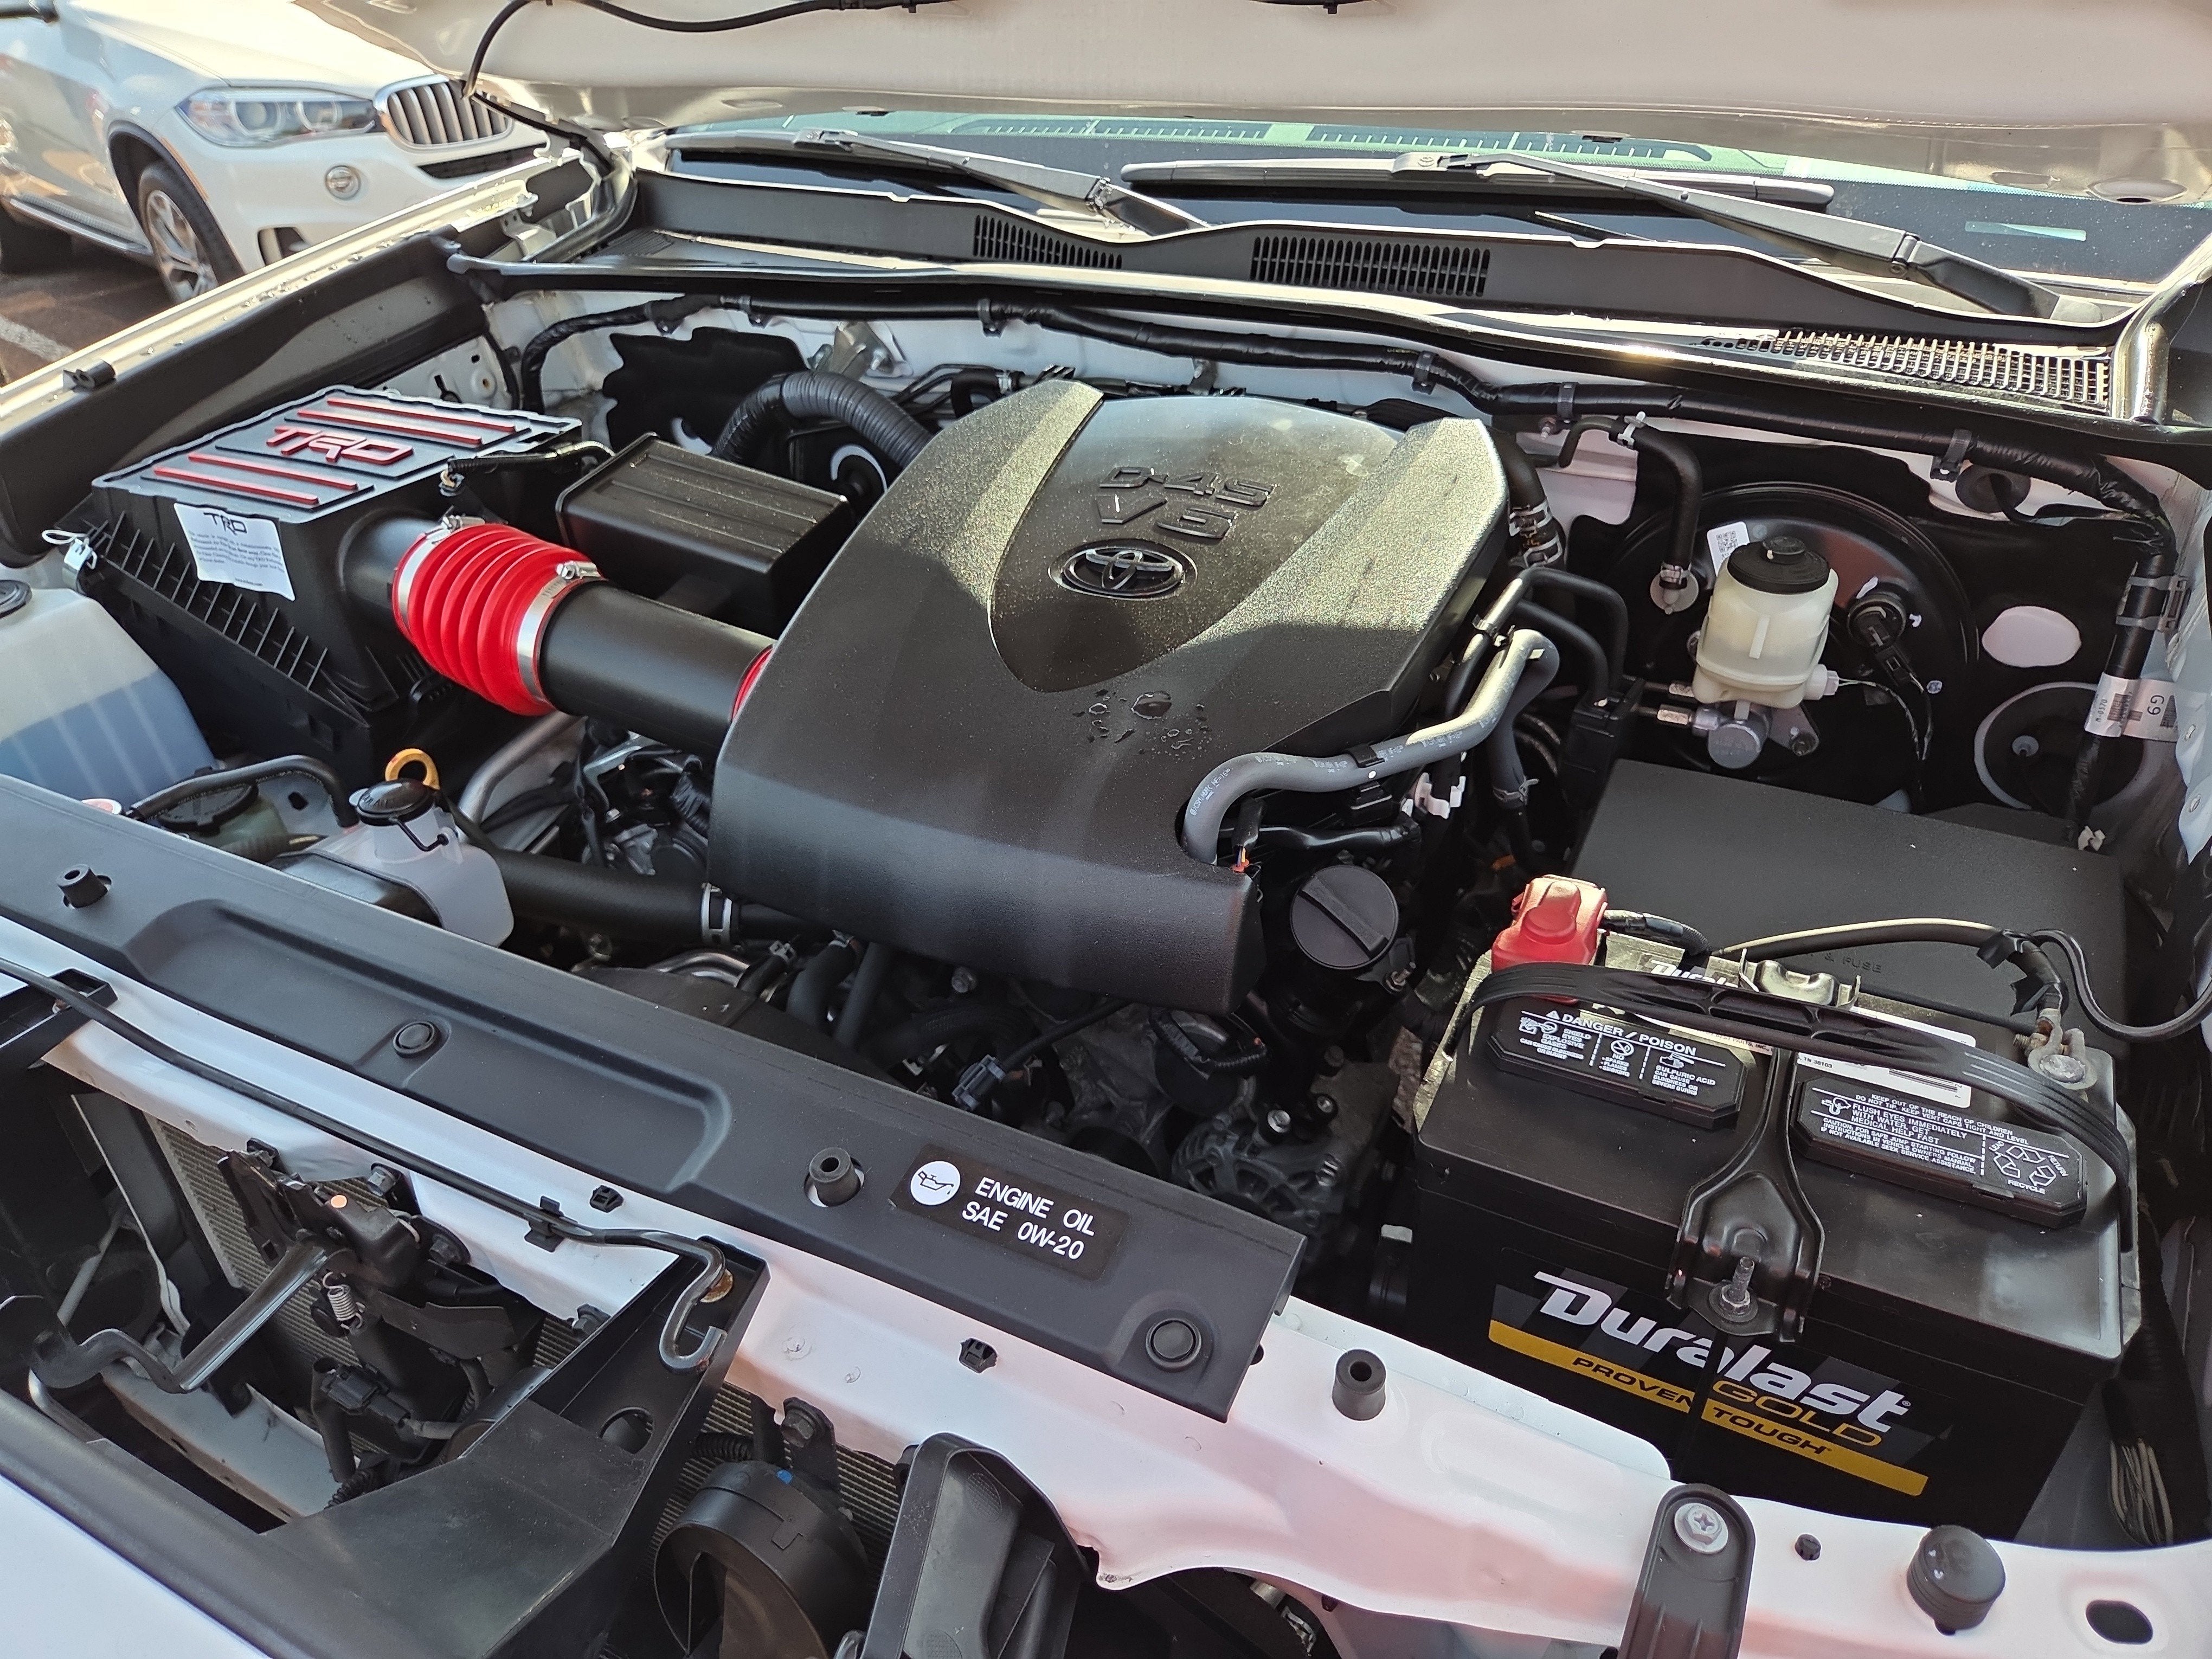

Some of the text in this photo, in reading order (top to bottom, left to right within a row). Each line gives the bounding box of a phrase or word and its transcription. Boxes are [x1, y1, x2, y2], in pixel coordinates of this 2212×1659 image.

[267, 426, 413, 466] TRD
[203, 512, 247, 536] TRD
[1095, 494, 1237, 539] V6
[2147, 695, 2164, 715] G9
[1842, 956, 1882, 973] FUSE
[1540, 1038, 1567, 1049] GASES
[1542, 1033, 1585, 1049] EXPLOSIVE
[1561, 1033, 1583, 1043] EYES
[1562, 1013, 1624, 1037] DANGER
[1638, 1033, 1697, 1056] POISON
[1563, 1028, 1592, 1040] SHIELD
[1655, 1065, 1716, 1086] SULFURIC ACID
[1813, 1058, 1833, 1069] 38103
[1851, 1115, 1940, 1144] MEDICAL HELP FAST
[1852, 1103, 1967, 1140] FLUSH EYES IMMEDIATELY
[1852, 1109, 1874, 1121] WITH
[1912, 1125, 1931, 1136] GET
[1868, 1098, 1884, 1107] NOT
[1901, 1107, 1920, 1116] KEEP
[1921, 1112, 1941, 1122] VENT
[1943, 1117, 1963, 1127] CAPS
[1965, 1123, 1988, 1134] TIGHT
[1989, 1129, 2005, 1139] AND
[2005, 1134, 2029, 1145] LEVEL
[1872, 1094, 1890, 1103] KEEP
[1891, 1098, 1907, 1107] OUT
[1921, 1107, 1937, 1115] THE
[1938, 1111, 1963, 1123] REACH
[1976, 1121, 2014, 1136] CHILDREN
[1823, 1122, 1871, 1142] INSTRUCTIONS
[1882, 1137, 1910, 1152] VEHICLE
[1911, 1146, 1942, 1159] OWNERS
[1828, 1128, 1844, 1138] NOT
[1844, 1133, 1880, 1148] AVAILABLE
[1881, 1143, 1899, 1154] SEEK
[1900, 1149, 1930, 1161] SERVICE
[1855, 1125, 1870, 1134] FOR
[1870, 1130, 1888, 1139] SAFE
[1890, 1135, 1909, 1145] JUMP
[1911, 1141, 1945, 1155] STARTING
[1947, 1150, 1976, 1163] FOLLOW
[2047, 1155, 2069, 1177] RETURN
[2007, 1179, 2046, 1195] RECYCLE
[974, 1176, 1095, 1237] ENGINE OIL
[962, 1200, 1084, 1261] SAE 0W-20
[1534, 1271, 1909, 1432] Duralast
[1572, 1356, 1826, 1455] PROVEN TOUGH
[1712, 1380, 1882, 1448] GOLD
